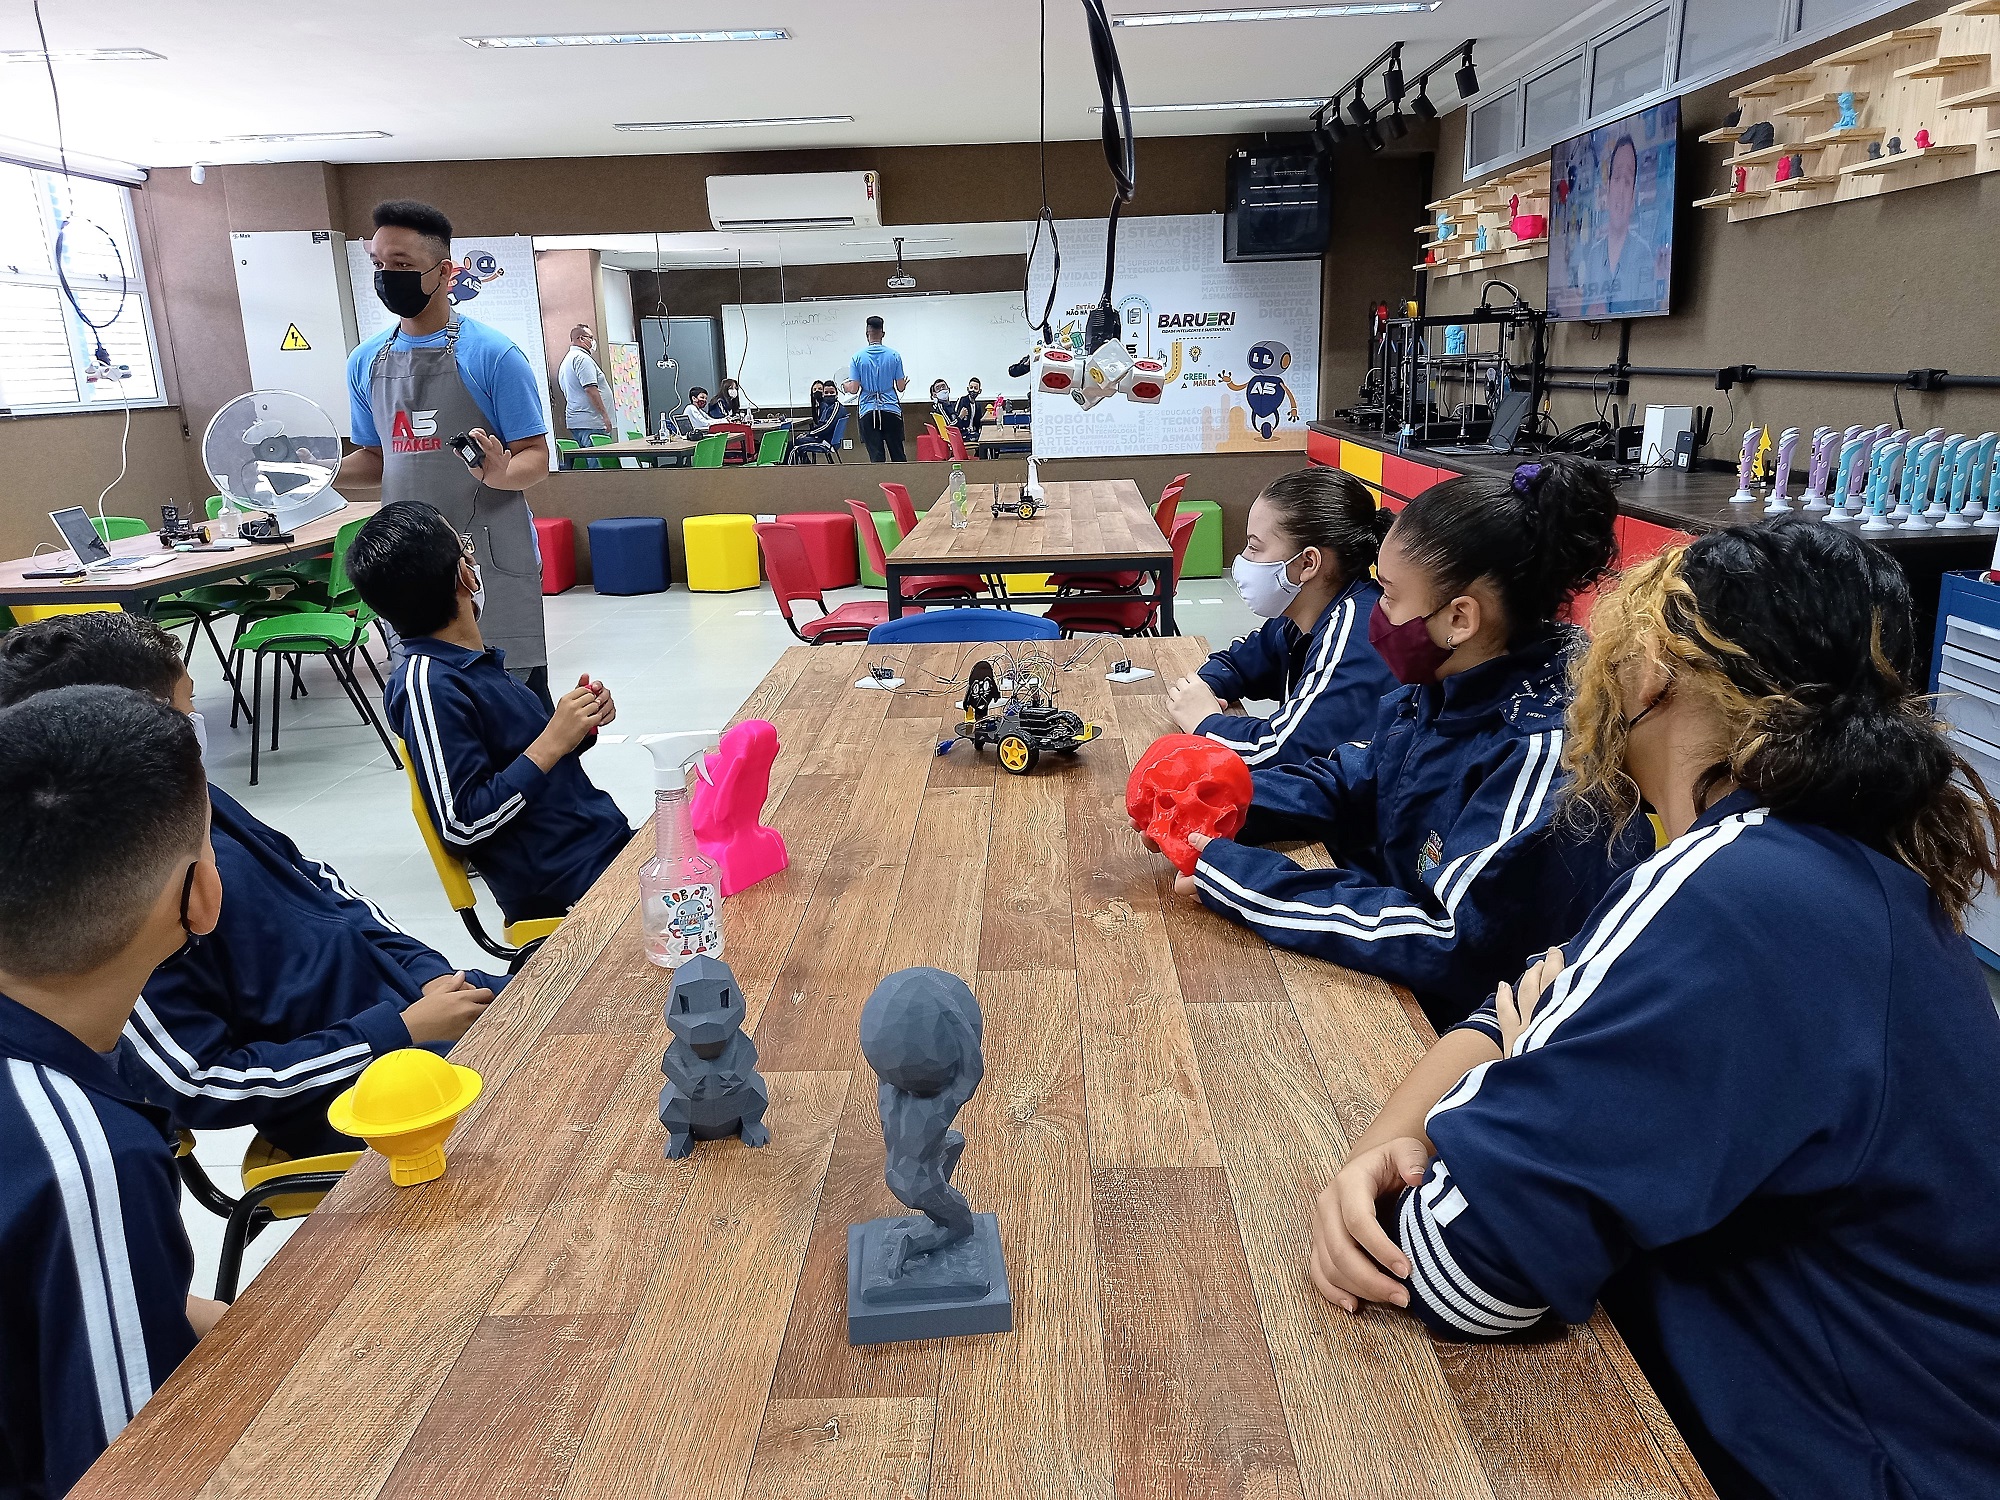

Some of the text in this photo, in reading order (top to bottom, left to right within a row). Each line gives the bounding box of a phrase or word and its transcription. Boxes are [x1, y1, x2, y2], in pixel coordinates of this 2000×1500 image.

[1128, 224, 1181, 238] STEAM
[1128, 258, 1181, 266] SUPERMAKER
[1126, 266, 1181, 274] TECNOLOGIA
[1202, 284, 1260, 293] MATEMÁTICA
[1244, 290, 1282, 298] CULTURA
[1076, 302, 1096, 310] ENTÃO
[1258, 306, 1314, 318] DIGITAL
[1158, 312, 1236, 328] BARUERI
[1293, 326, 1302, 372] DIGITAL
[1303, 326, 1312, 372] DESIGN
[1161, 408, 1202, 416] EDUCAÇÃO
[1045, 412, 1114, 425] ROBÓTICA
[392, 410, 438, 440] A5
[1045, 424, 1094, 436] DESIGN
[392, 438, 442, 452] MAKER
[1038, 436, 1078, 446] ARTES
[1120, 434, 1138, 445] 5.0
[1038, 444, 1160, 454] STEAM CULTURA MAKER
